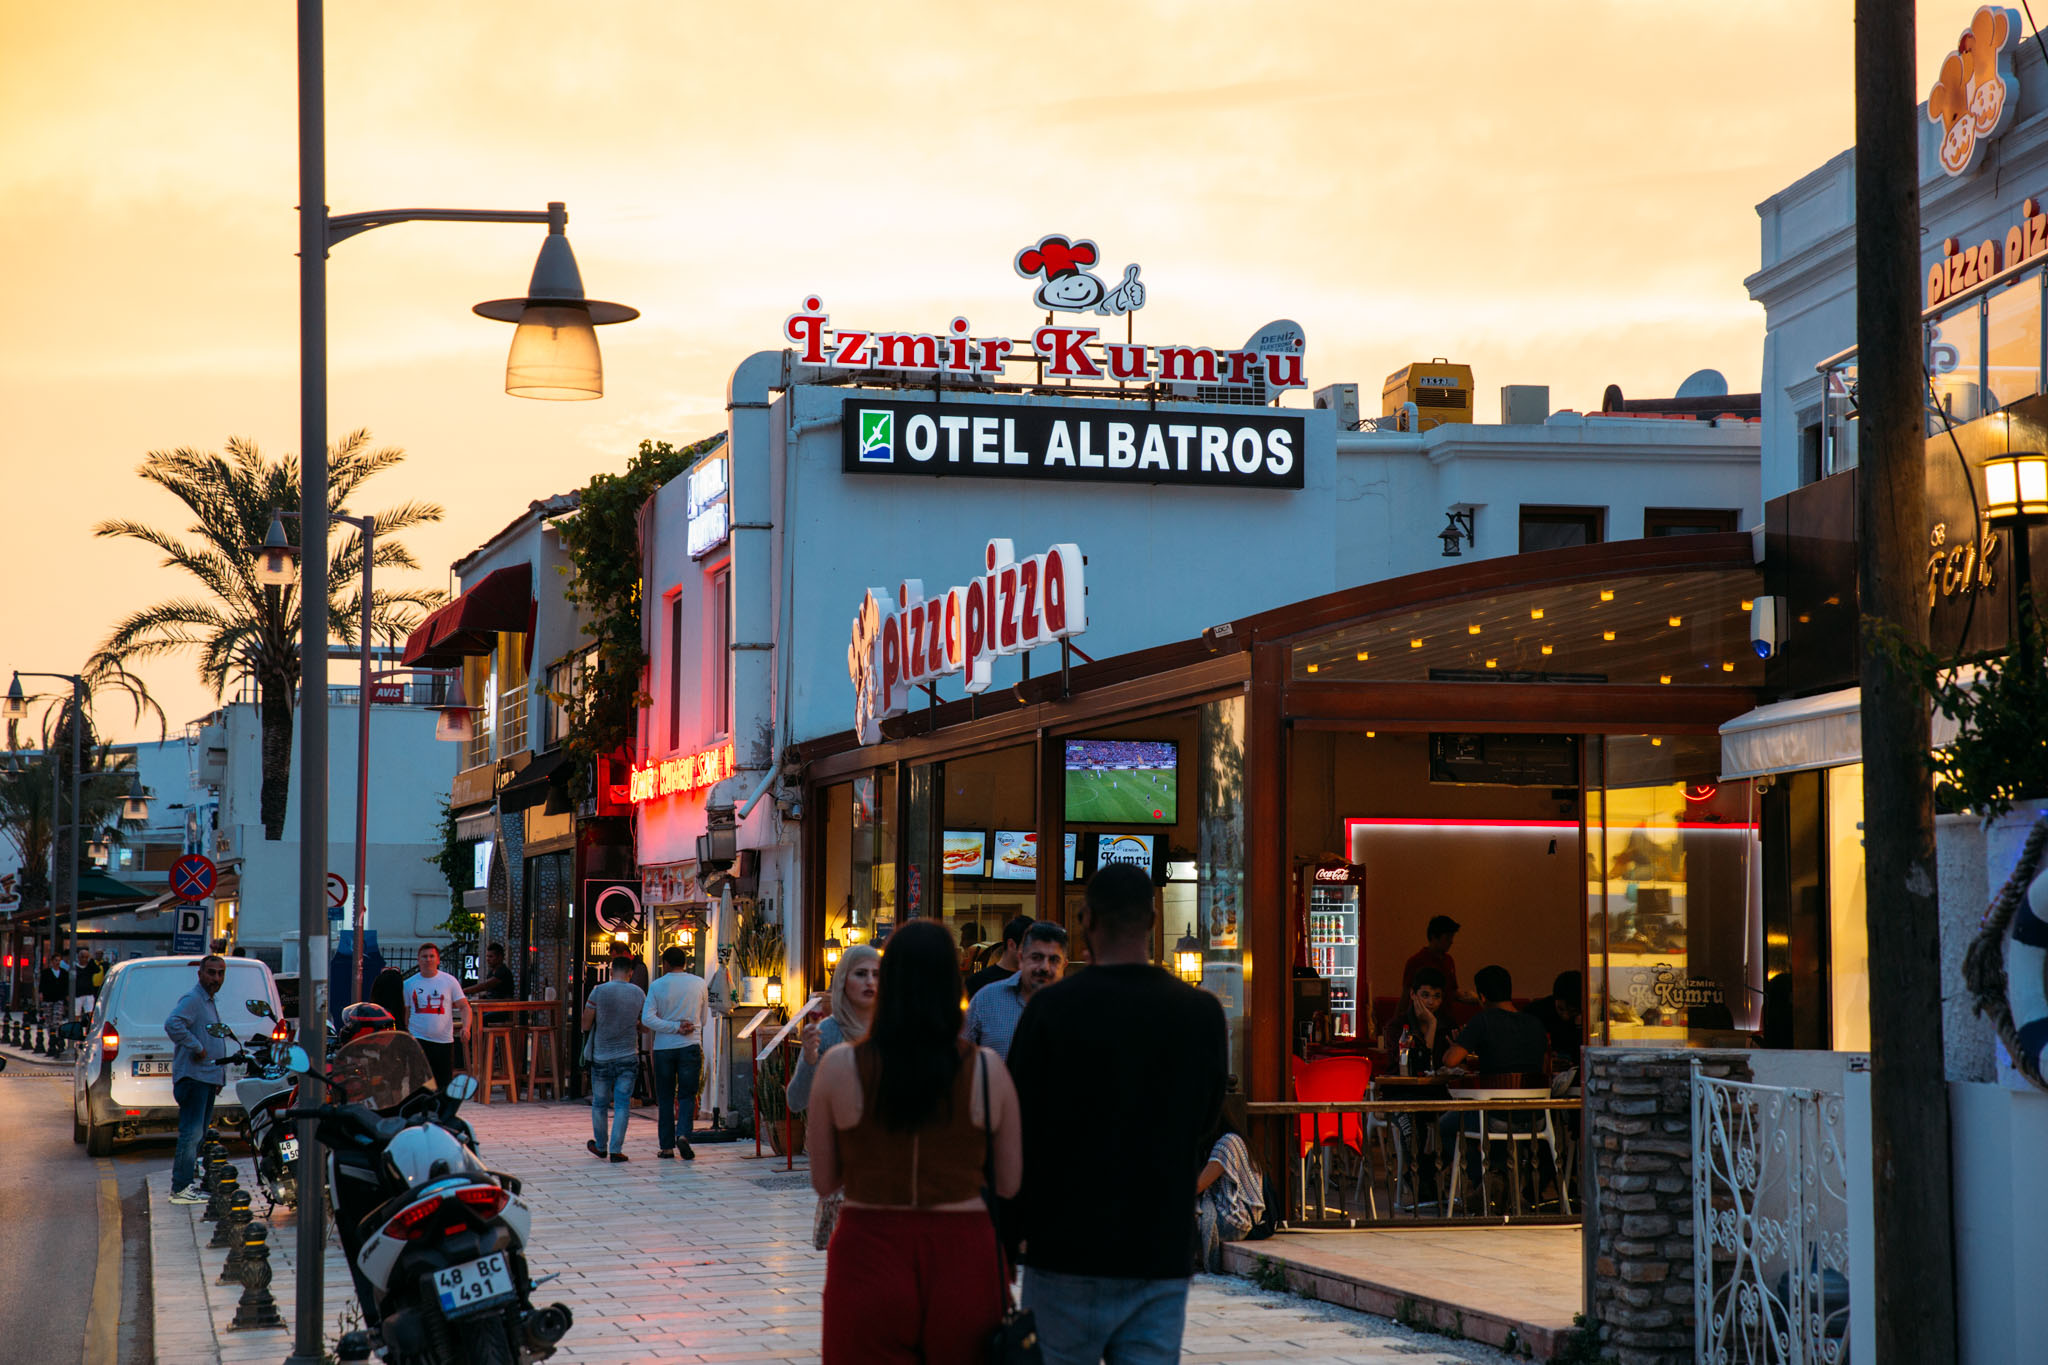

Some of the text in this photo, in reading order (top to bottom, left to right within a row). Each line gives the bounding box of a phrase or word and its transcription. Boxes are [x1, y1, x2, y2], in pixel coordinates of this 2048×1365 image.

[1927, 198, 2048, 321] pizza piz
[787, 297, 1305, 386] İzmir Kumru
[906, 414, 1294, 475] OTEL ALBATROS
[375, 687, 401, 697] AVIS
[182, 912, 200, 932] D
[590, 942, 611, 956] HAIR
[1654, 982, 1725, 1009] Kumru
[139, 1062, 170, 1073] 48 BK
[281, 1141, 292, 1151] 48
[440, 1257, 502, 1287] 48 BC
[460, 1279, 494, 1301] 491
